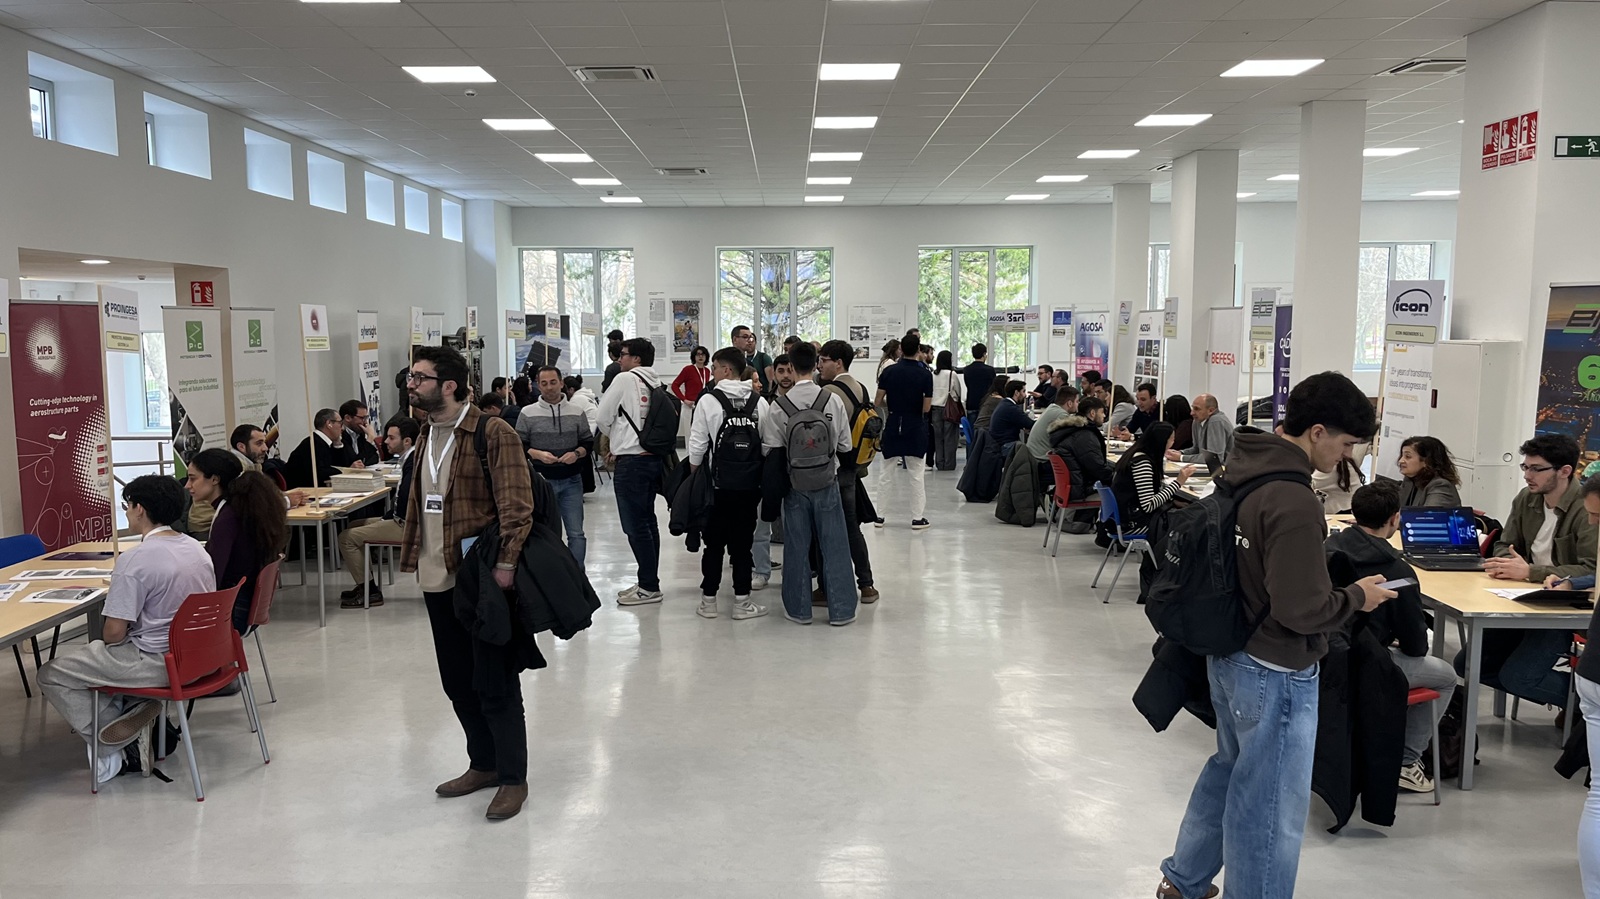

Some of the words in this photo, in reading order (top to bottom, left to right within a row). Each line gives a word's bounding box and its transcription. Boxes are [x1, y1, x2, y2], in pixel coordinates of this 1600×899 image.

[110, 302, 138, 315] PROINGESA
[1395, 296, 1429, 312] icon
[1080, 322, 1104, 332] AGOSA
[36, 346, 52, 355] MPB
[1211, 352, 1235, 366] BEFESA
[30, 396, 61, 406] Cutting-edge
[62, 394, 92, 404] technology
[30, 408, 64, 416] aerostructure
[64, 406, 79, 414] parts
[76, 514, 112, 542] MPB
